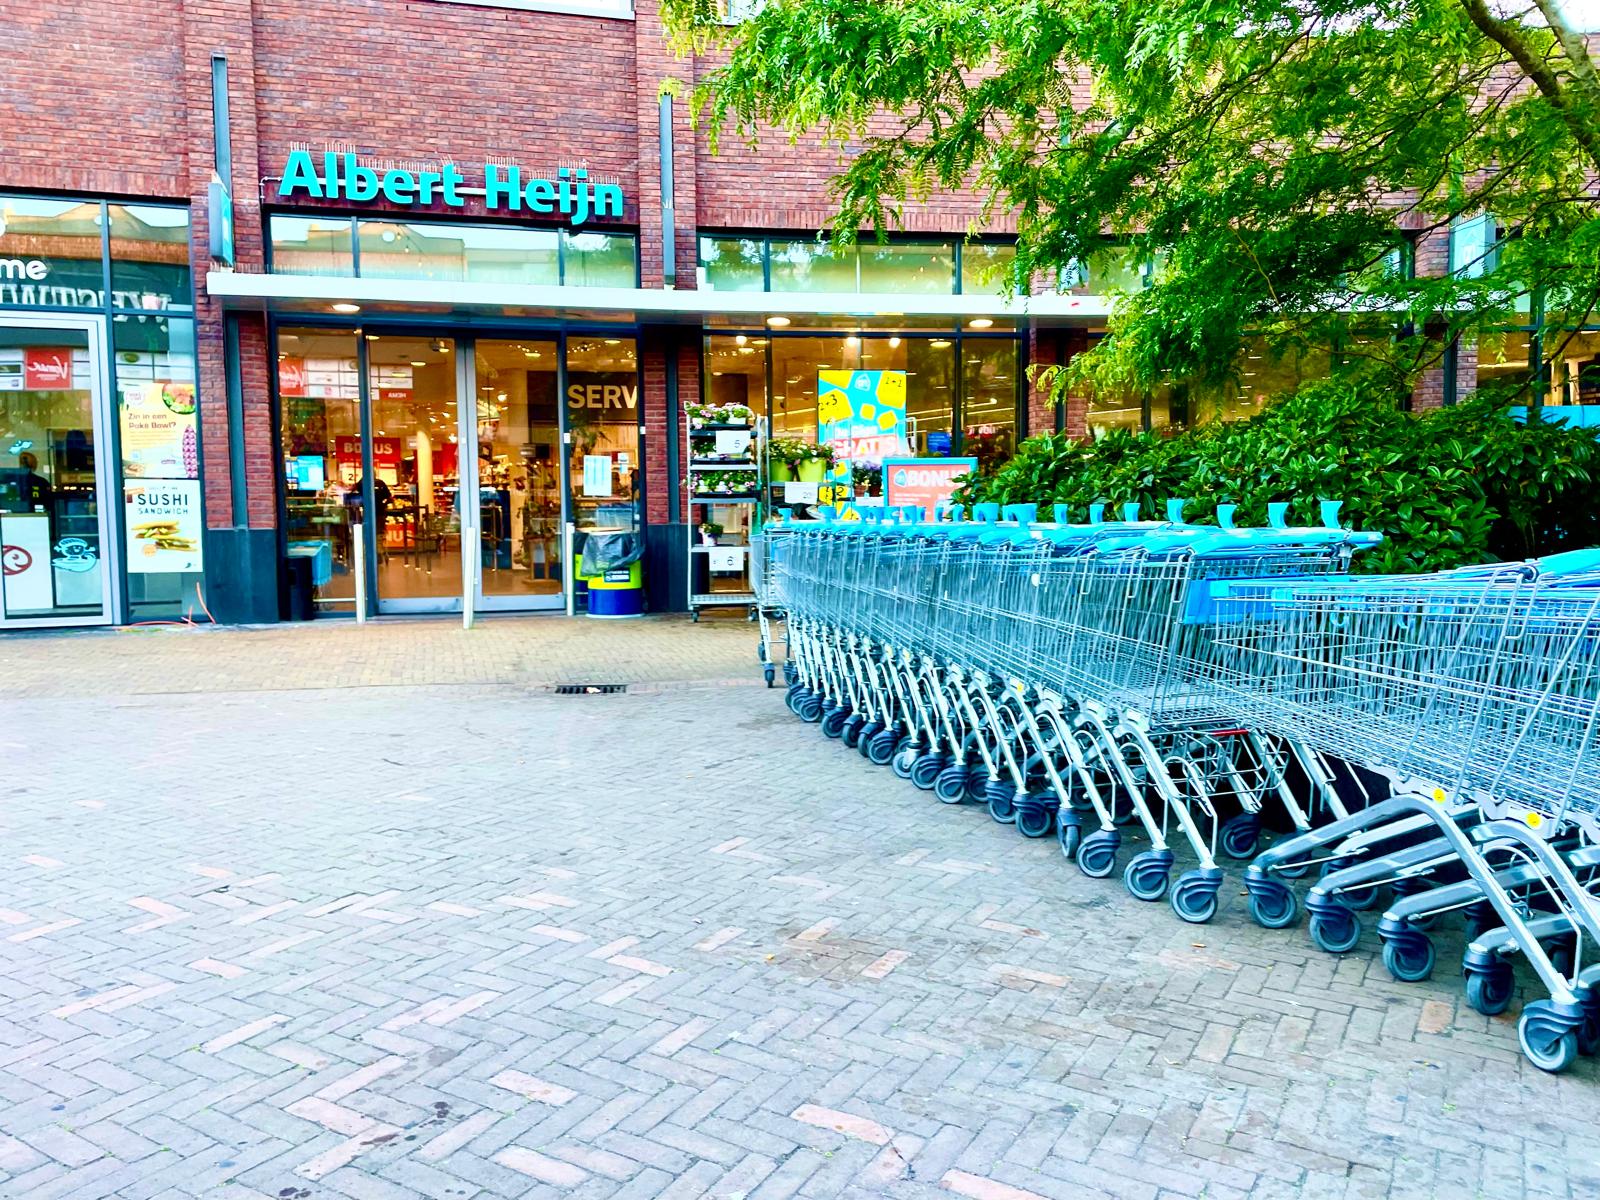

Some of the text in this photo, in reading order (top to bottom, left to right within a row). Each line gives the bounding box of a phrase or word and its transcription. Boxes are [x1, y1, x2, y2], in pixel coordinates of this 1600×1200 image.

[279, 150, 624, 226] Albert Heijn
[152, 421, 177, 429] Bowl?
[138, 493, 188, 506] SUSHI
[138, 507, 188, 515] SANDWICH
